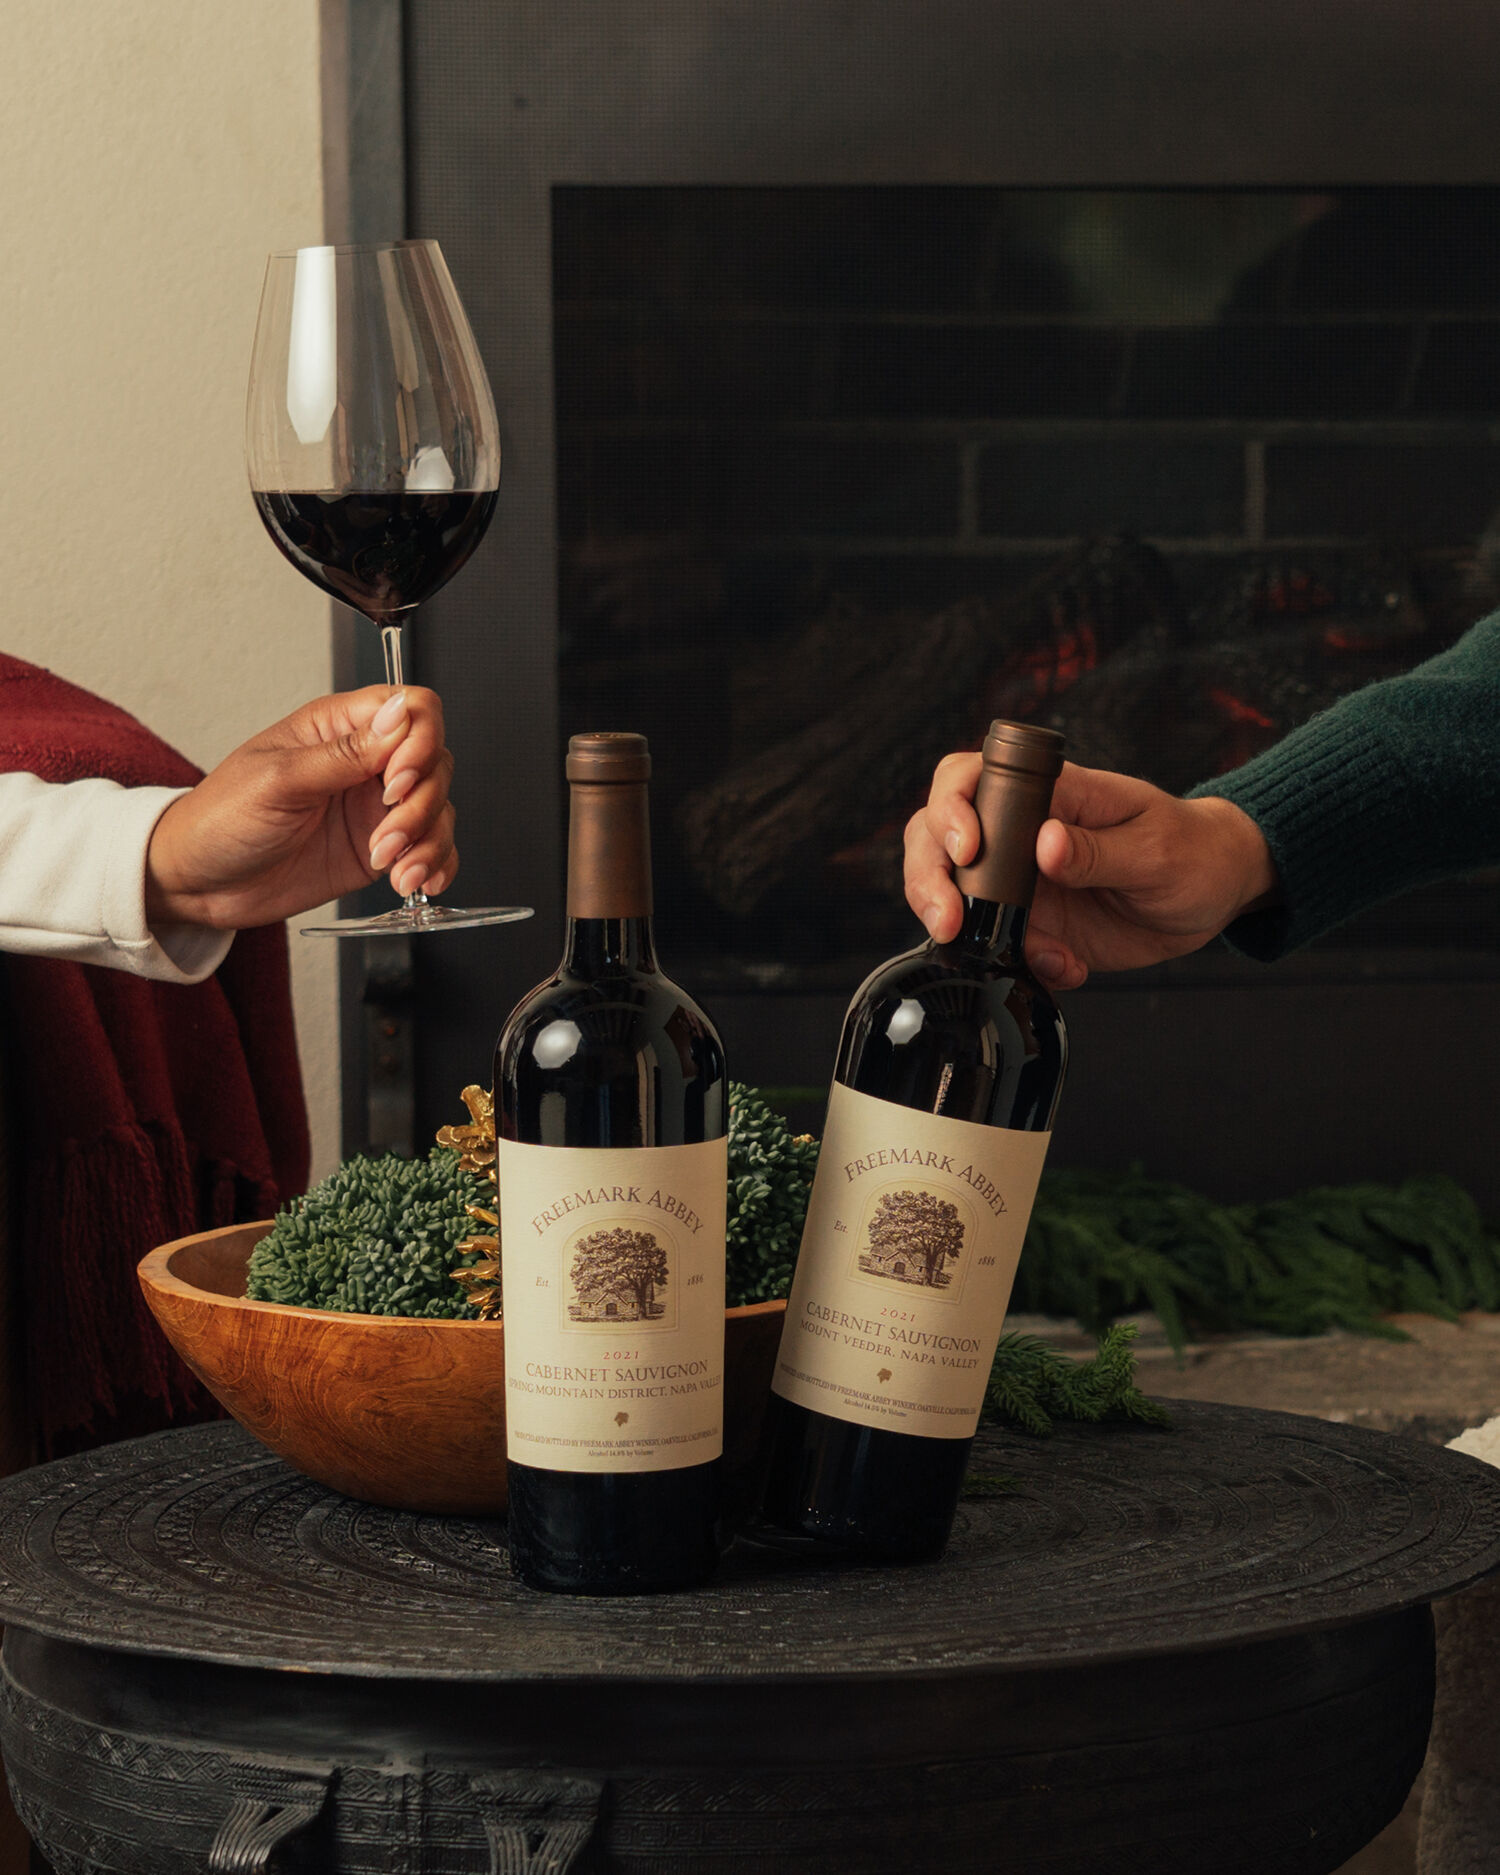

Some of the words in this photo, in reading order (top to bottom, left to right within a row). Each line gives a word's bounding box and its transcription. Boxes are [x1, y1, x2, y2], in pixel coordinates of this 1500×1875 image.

[843, 1147, 956, 1184] FREEMARK
[957, 1164, 1009, 1217] ABBEY
[531, 1186, 641, 1237] FREEMARK
[647, 1189, 704, 1235] ABBEY
[880, 1307, 916, 1322] 2021
[806, 1301, 886, 1337] CABERNET
[888, 1326, 981, 1353] SAUVIGNON
[800, 1319, 840, 1342] MOUNT
[901, 1349, 936, 1365] NAPA
[941, 1356, 979, 1369] VALLEY
[602, 1351, 640, 1361] 2021
[526, 1362, 612, 1382] CABERNET
[615, 1359, 709, 1382] SAUVIGNON
[536, 1384, 604, 1399] MOUNTAIN
[670, 1383, 698, 1397] NAPA
[837, 1386, 871, 1401] FREEMARK
[871, 1394, 891, 1406] ABBEY
[580, 1439, 614, 1448] FREEMARK
[614, 1439, 635, 1448] ABBEY
